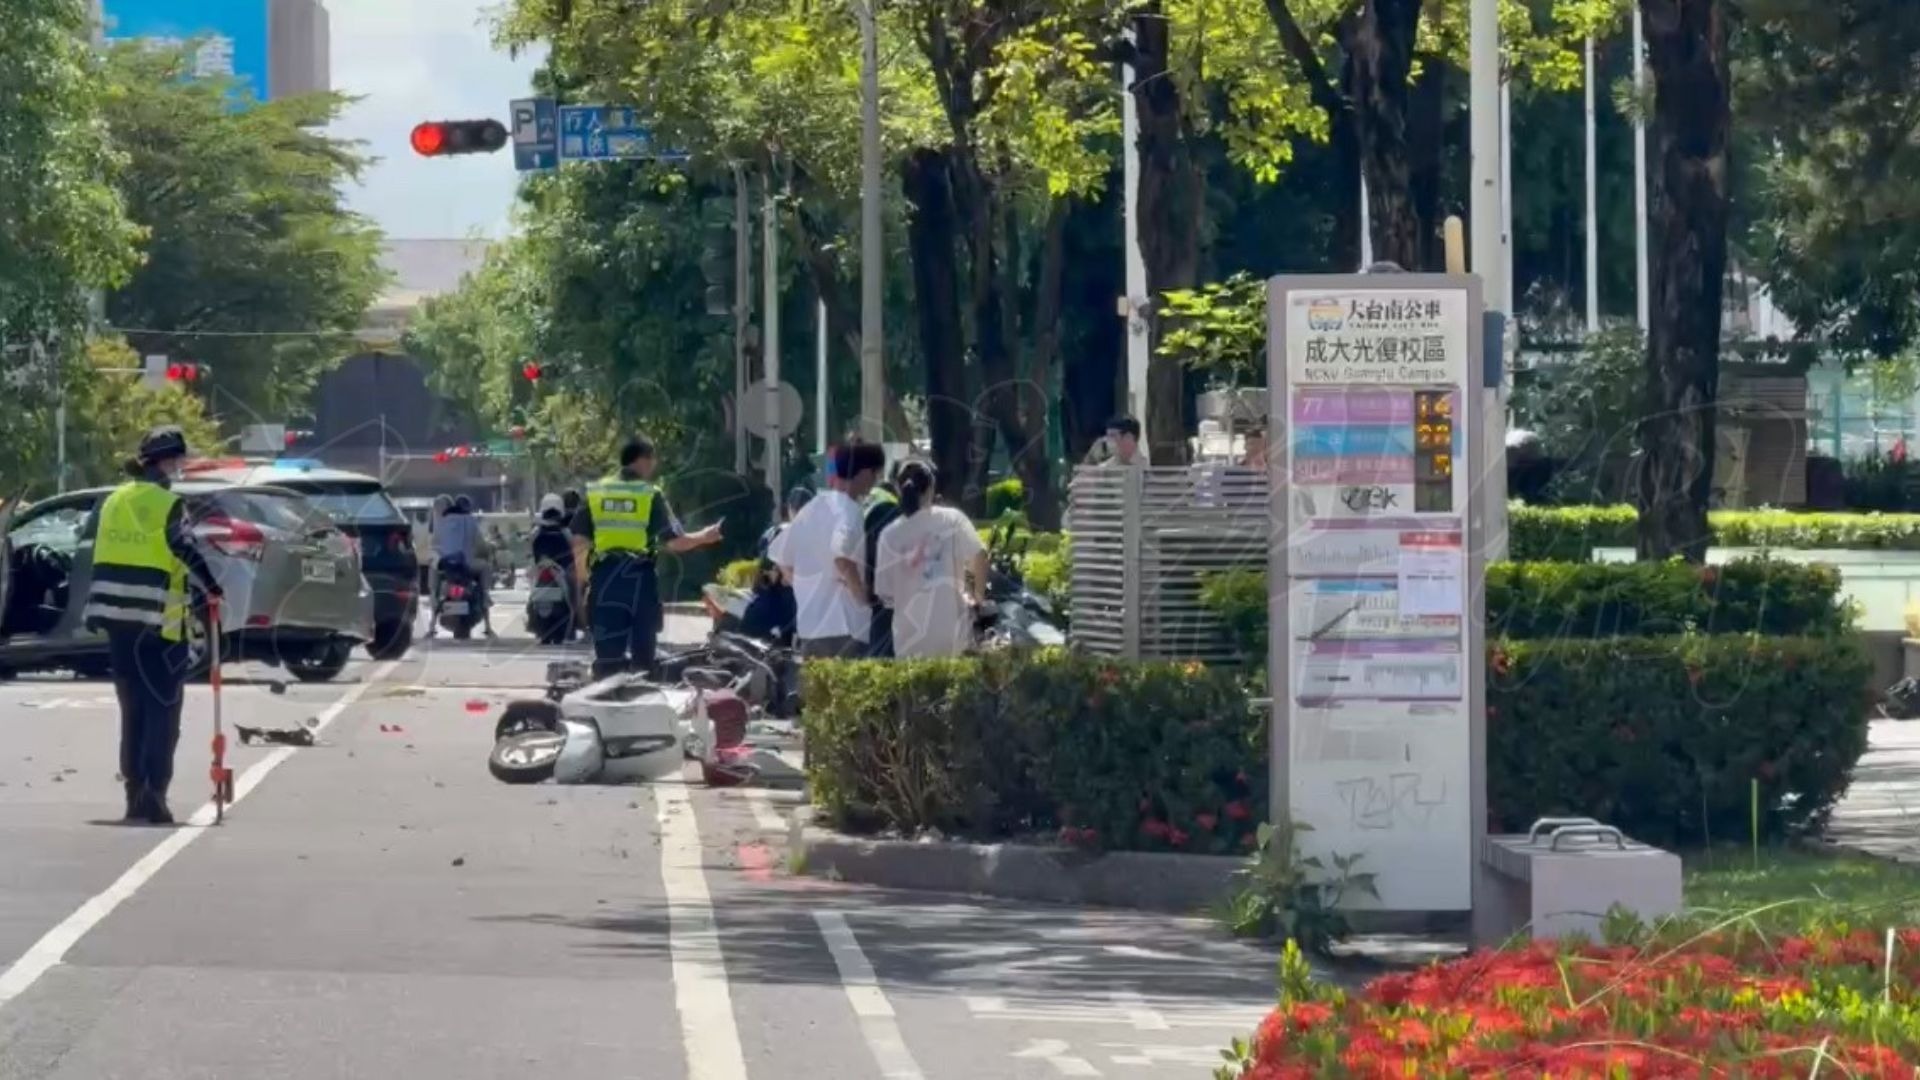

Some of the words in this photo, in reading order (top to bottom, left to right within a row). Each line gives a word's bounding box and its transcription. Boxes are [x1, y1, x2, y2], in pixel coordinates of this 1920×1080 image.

[1348, 299, 1441, 320] 大台南公車
[1305, 336, 1446, 363] 成大光復校區
[1399, 366, 1447, 380] Campus
